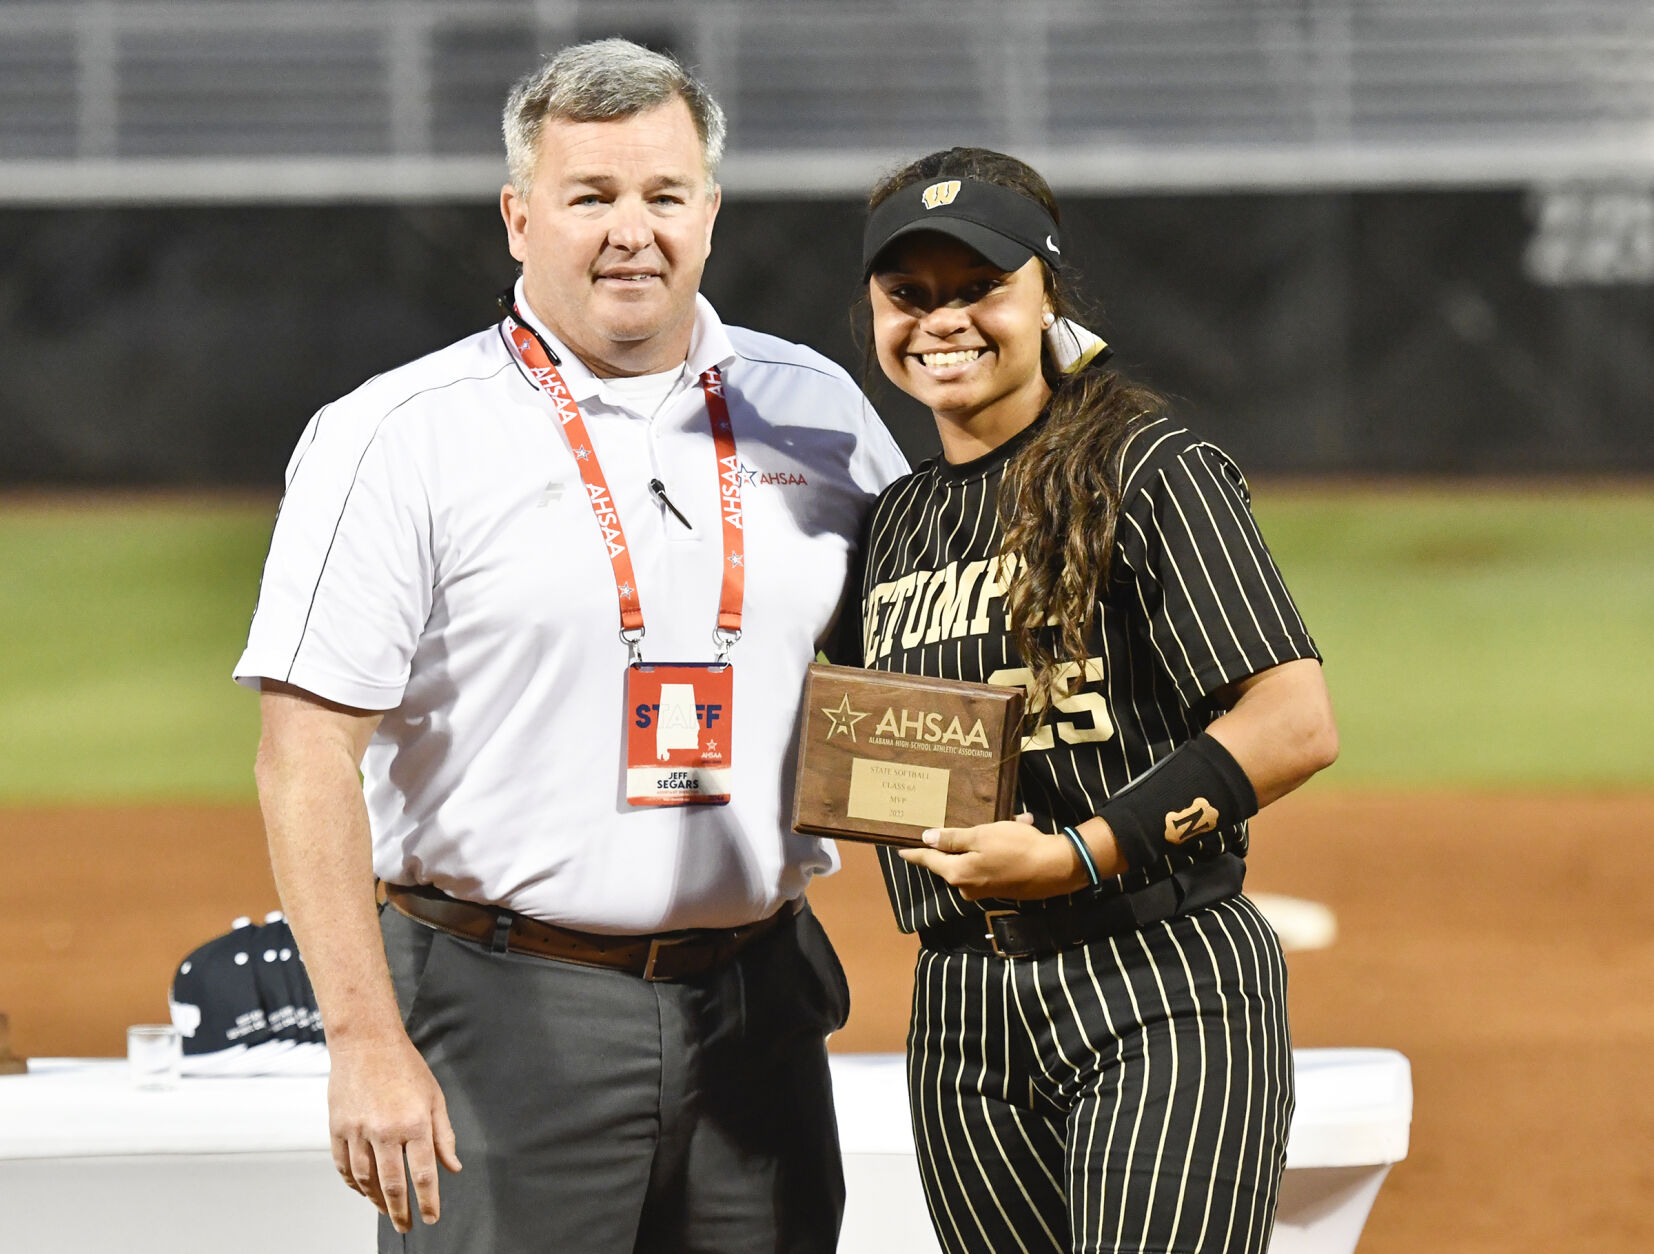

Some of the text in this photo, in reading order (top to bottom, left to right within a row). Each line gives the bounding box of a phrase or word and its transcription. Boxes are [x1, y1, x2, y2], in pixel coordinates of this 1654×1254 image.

[922, 181, 961, 209] W
[530, 366, 577, 425] AHSAA
[720, 455, 744, 529] AHSAA
[759, 472, 808, 486] AHSAA
[586, 482, 625, 558] AHSAA
[635, 703, 723, 729] STAFF
[875, 707, 990, 749] AHSAA
[868, 736, 993, 758] ALABAMA HIGH SCHOOL ATHLETIC ASSOCIATION
[657, 779, 699, 789] SEGARS
[668, 772, 688, 780] JEFF
